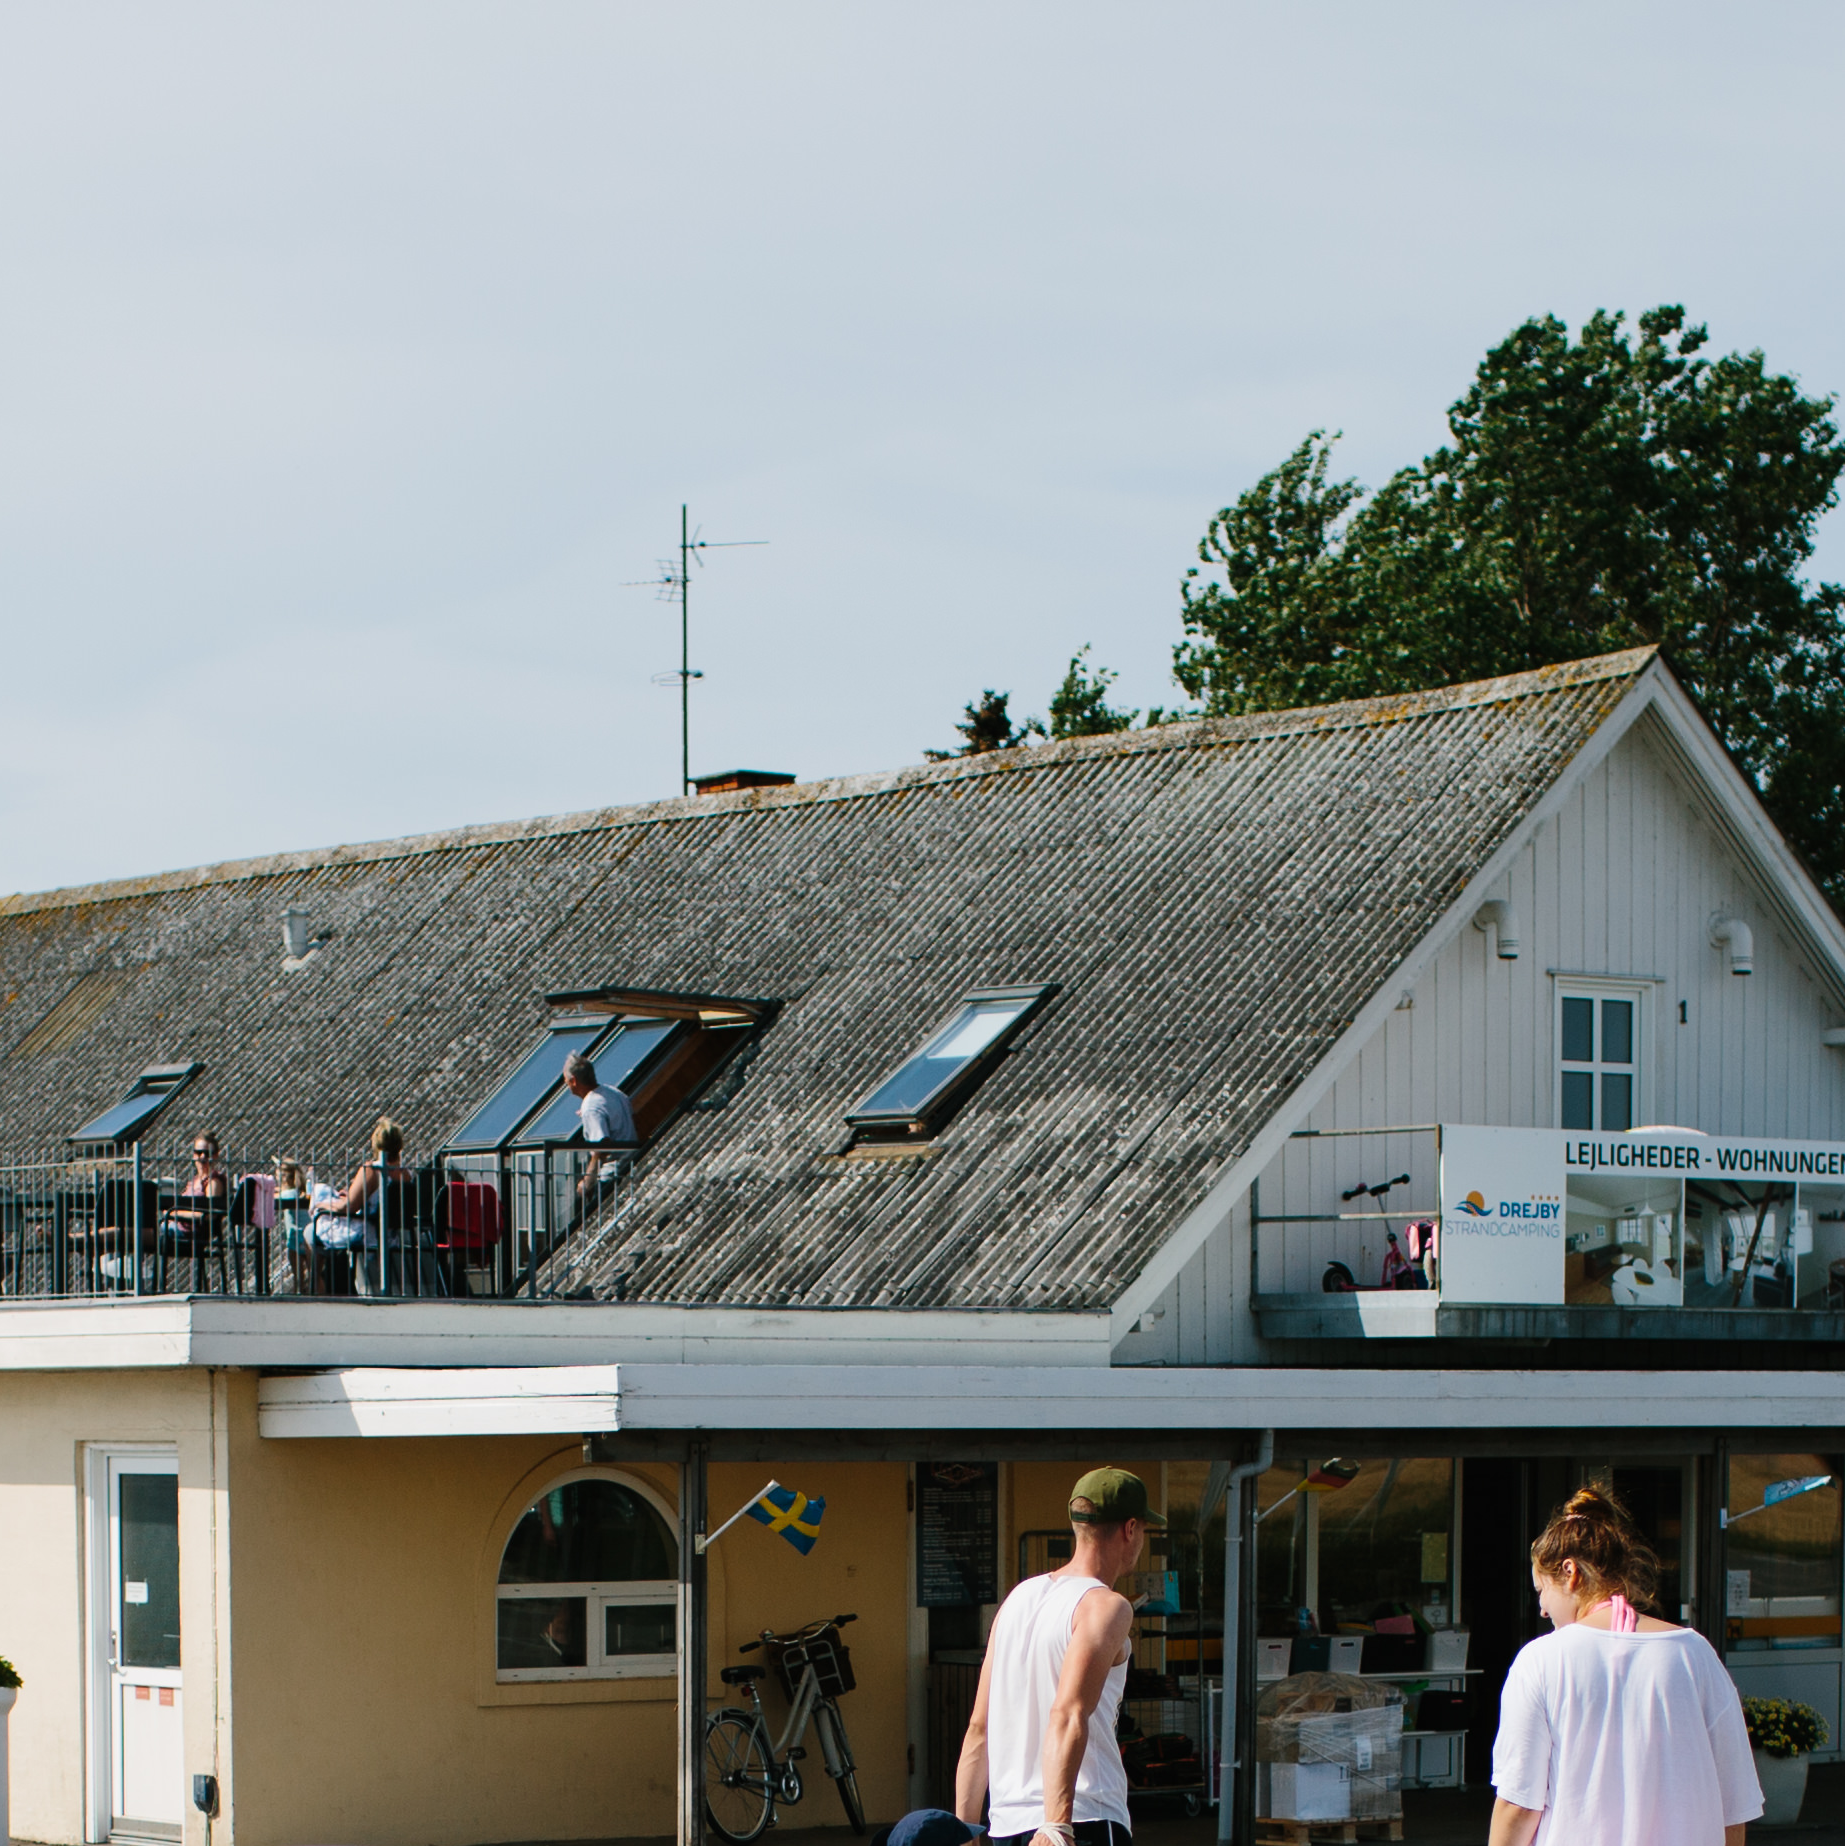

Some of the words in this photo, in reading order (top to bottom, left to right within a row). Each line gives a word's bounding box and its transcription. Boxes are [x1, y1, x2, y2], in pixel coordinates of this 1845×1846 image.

[1565, 1141, 1700, 1171] LEJLIGHEDER
[1499, 1201, 1560, 1219] DREJBY
[1445, 1220, 1560, 1238] STRANDCAMPING
